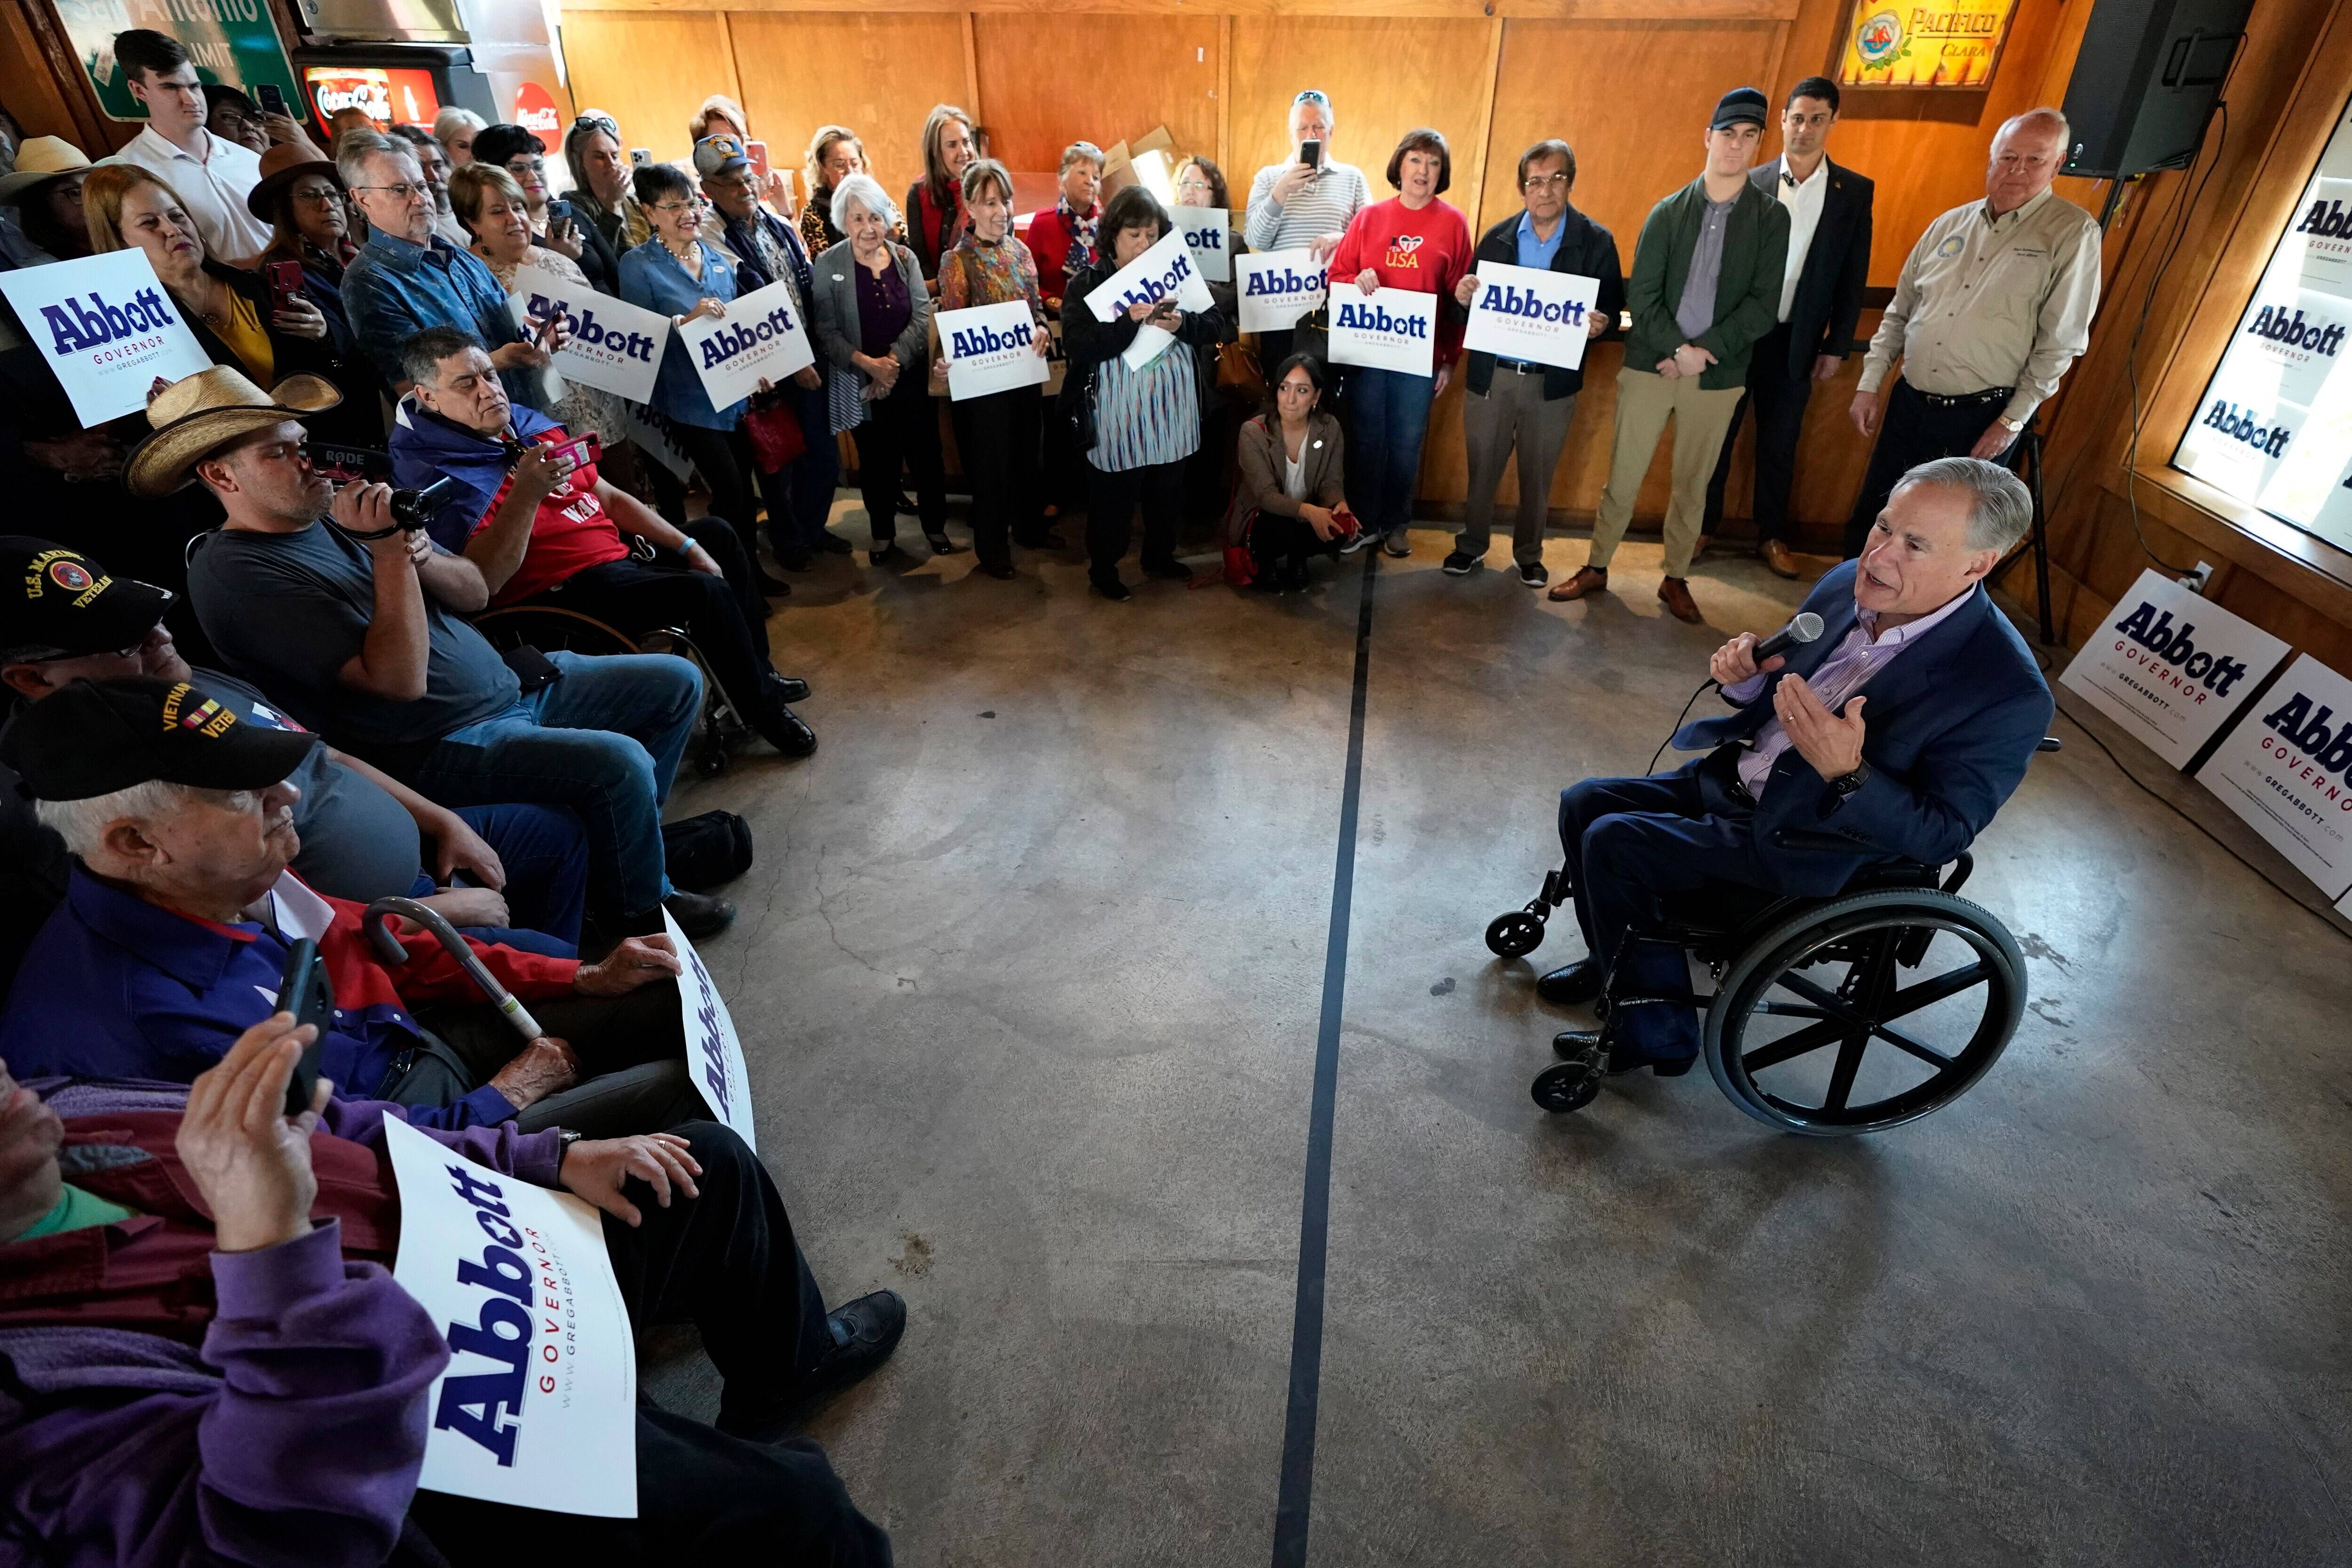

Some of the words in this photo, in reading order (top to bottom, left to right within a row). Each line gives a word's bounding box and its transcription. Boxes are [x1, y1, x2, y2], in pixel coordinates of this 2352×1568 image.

[140, 0, 258, 22] Antonio
[1907, 8, 1997, 35] PACIFICO
[1941, 43, 1986, 56] CLARA
[2296, 200, 2352, 239] Abb
[1385, 251, 1419, 268] USA
[2309, 240, 2352, 254] GOVERN
[1246, 268, 1328, 296] Abbot
[1264, 294, 1321, 304] GOVERNOR
[1480, 284, 1585, 326] Abbott
[40, 287, 175, 356] Abbott
[1337, 303, 1427, 339] Abbott
[1497, 317, 1559, 333] GOVERNOR
[2247, 305, 2345, 357] Abbott
[94, 336, 165, 364] GOVERNOR
[568, 342, 624, 364] ERNOR
[699, 306, 794, 370] Abbott
[952, 323, 1033, 359] Abbott
[1354, 332, 1409, 344] GOVERNOR
[725, 340, 780, 370] GOVERNOR
[972, 351, 1021, 366] GOVERNOR
[2203, 399, 2290, 459] Abbott
[326, 450, 365, 465] RØDE
[25, 573, 43, 599] U.S.
[72, 575, 113, 608] VETERAN
[2115, 601, 2247, 698] Abbott
[2114, 640, 2207, 705] GOVERNOR
[2261, 737, 2352, 812] GOVERNO
[687, 947, 731, 1125] Abbott
[434, 1163, 538, 1468] Abbott
[525, 1227, 560, 1393] GOVERNOR
